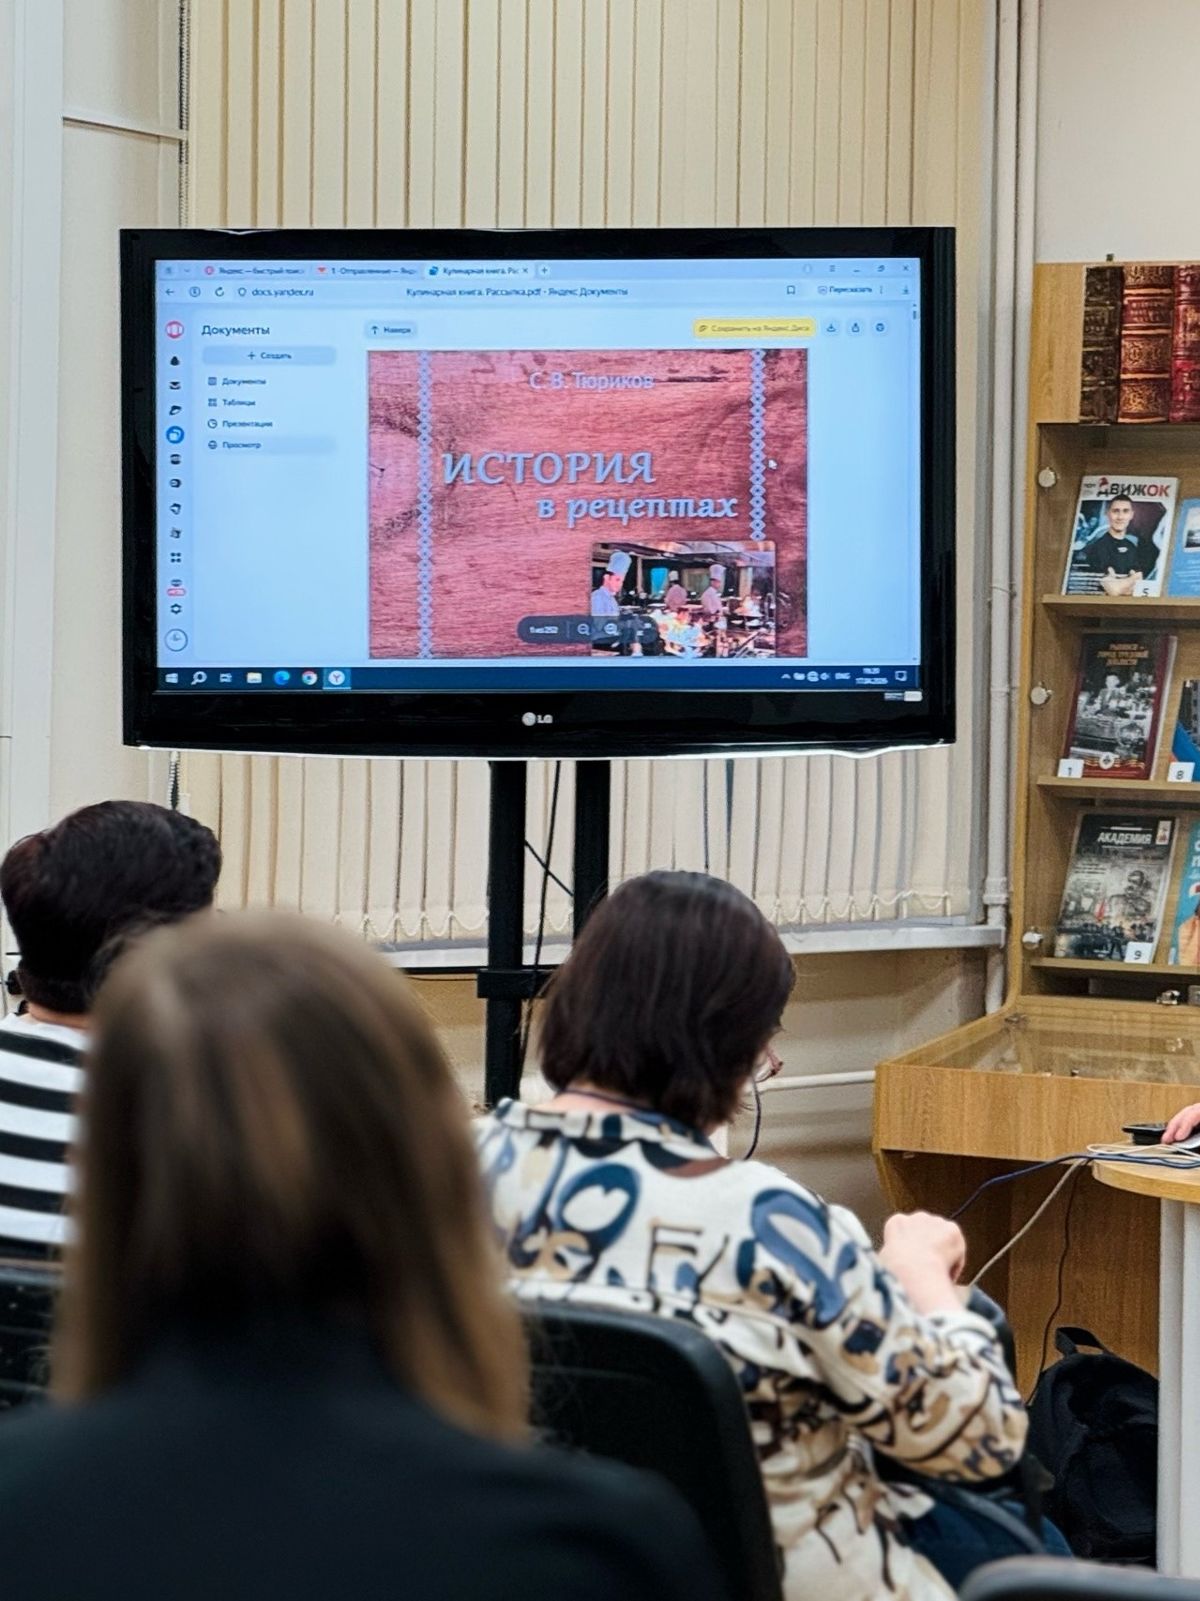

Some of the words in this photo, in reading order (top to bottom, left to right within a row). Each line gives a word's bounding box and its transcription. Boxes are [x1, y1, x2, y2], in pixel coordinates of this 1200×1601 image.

[252, 287, 314, 298] docs.yandex.ru
[406, 287, 457, 298] Кулинарная
[580, 287, 629, 298] Документы
[201, 324, 271, 337] Документы
[441, 451, 656, 485] ИСТОРИЯ
[1097, 477, 1171, 497] ДВИЖОК
[536, 498, 555, 519] в
[566, 497, 738, 529] рецептах
[1176, 770, 1184, 780] 8
[1097, 831, 1152, 845] АКАДЕМИЯ
[1134, 950, 1142, 960] 9
